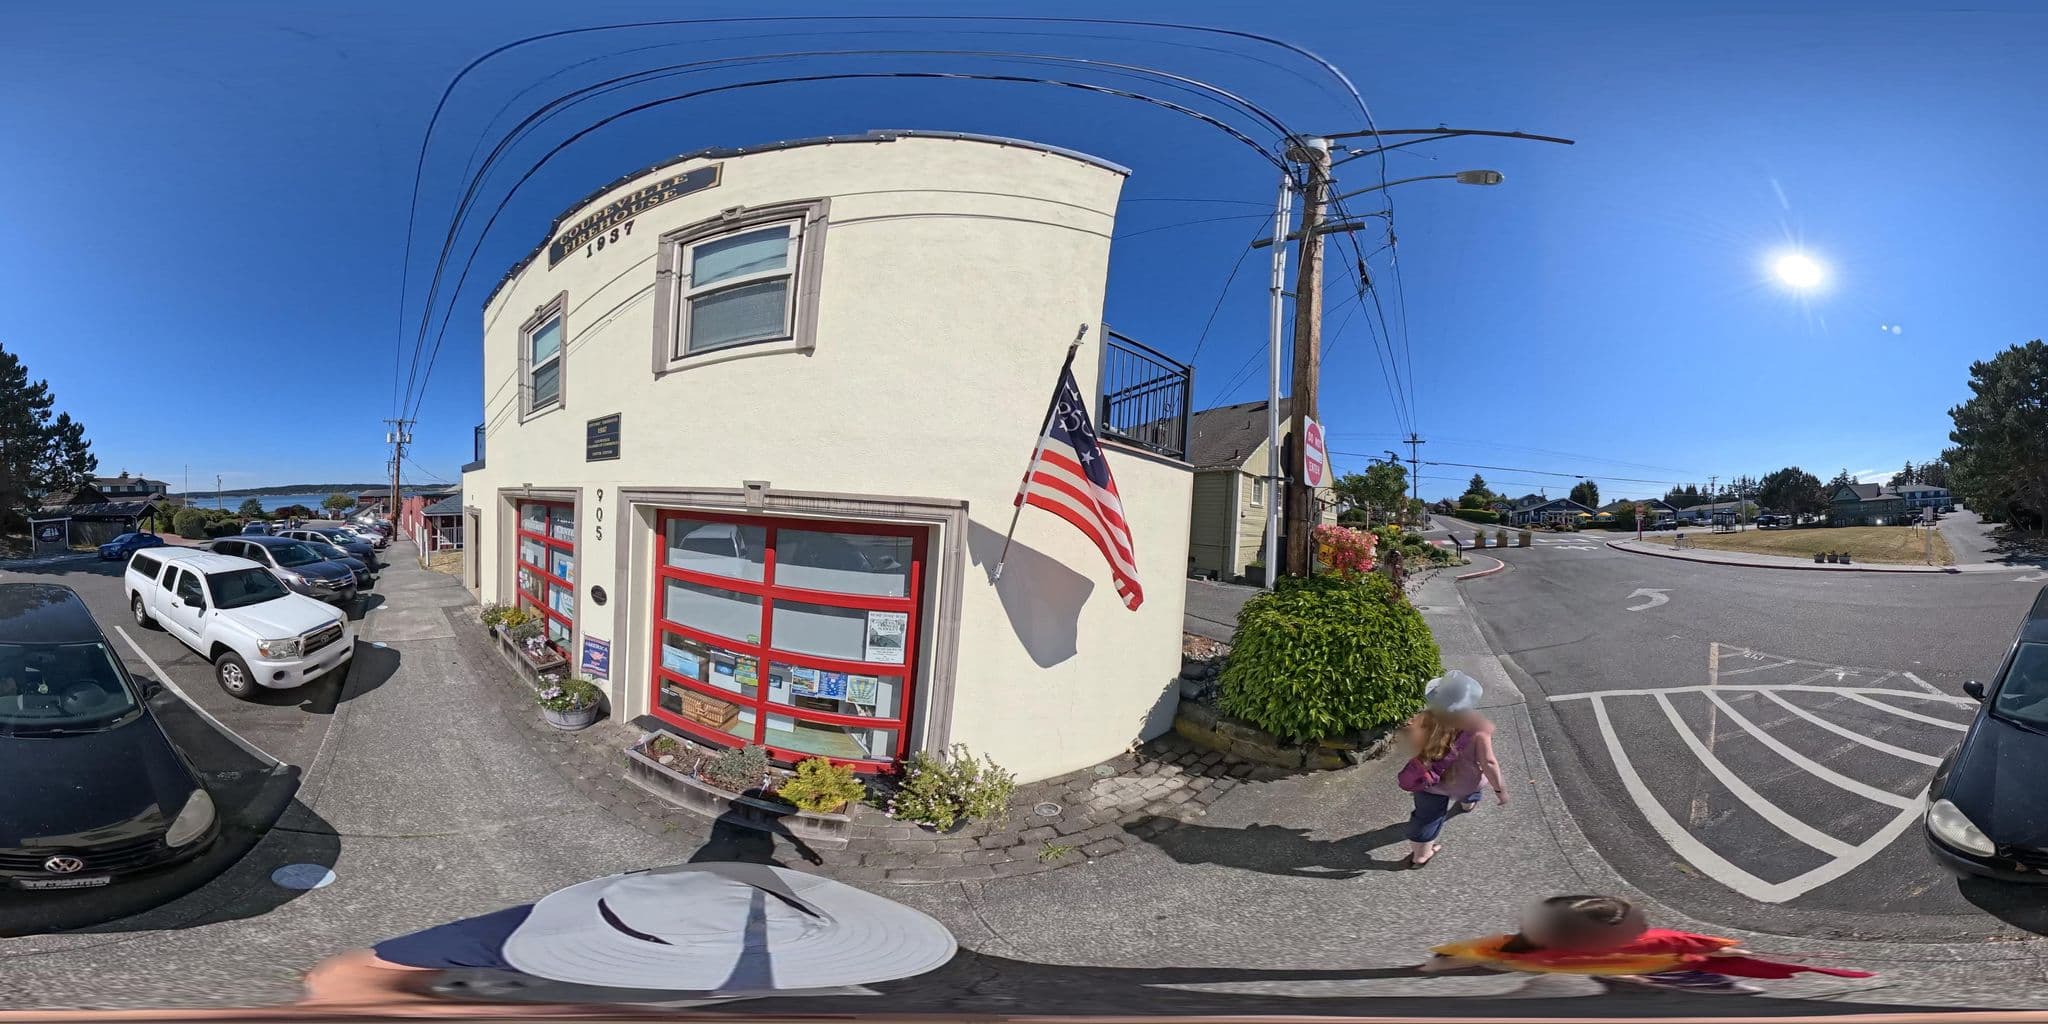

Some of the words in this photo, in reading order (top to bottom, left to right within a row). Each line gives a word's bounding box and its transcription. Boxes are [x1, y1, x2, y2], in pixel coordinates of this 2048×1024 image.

[559, 174, 689, 245] COUPEVILLE
[563, 188, 679, 255] FIREHOUSE
[586, 219, 635, 258] 1937
